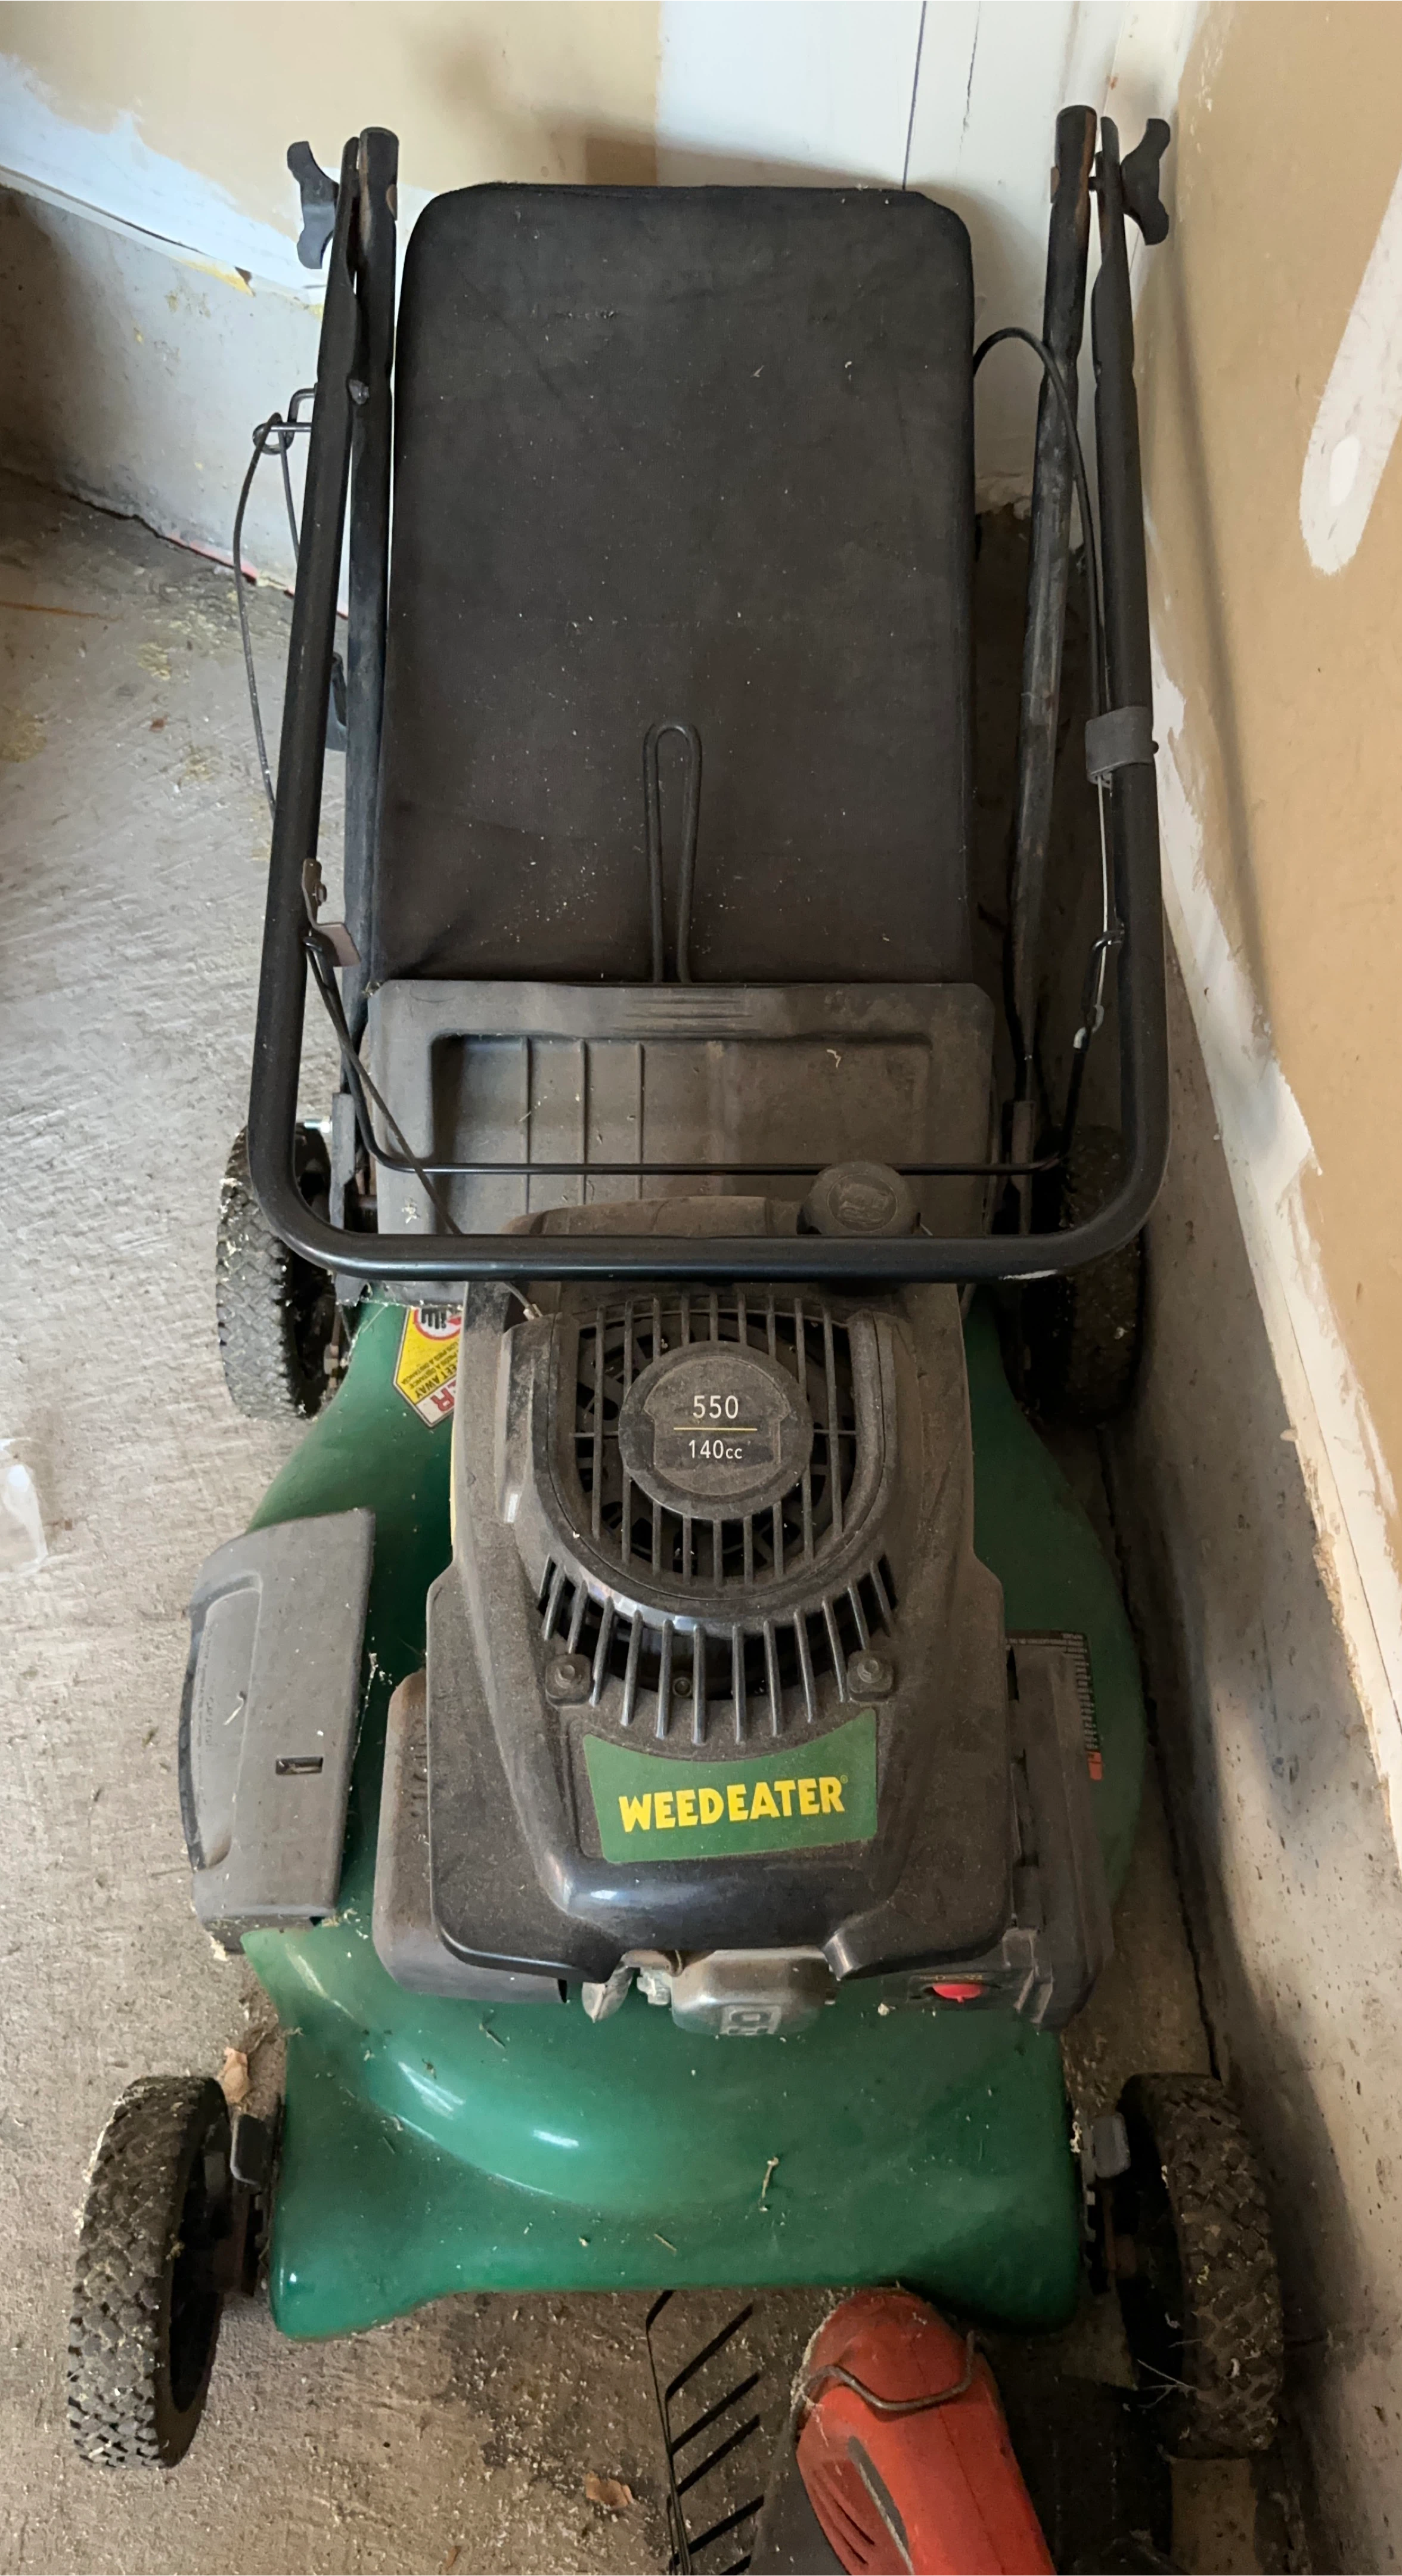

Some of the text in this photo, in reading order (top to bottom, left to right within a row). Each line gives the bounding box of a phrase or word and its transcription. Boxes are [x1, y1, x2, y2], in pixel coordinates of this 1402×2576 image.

[415, 1374, 440, 1398] AWAY
[693, 1395, 739, 1419] 550
[688, 1439, 743, 1459] 140cc
